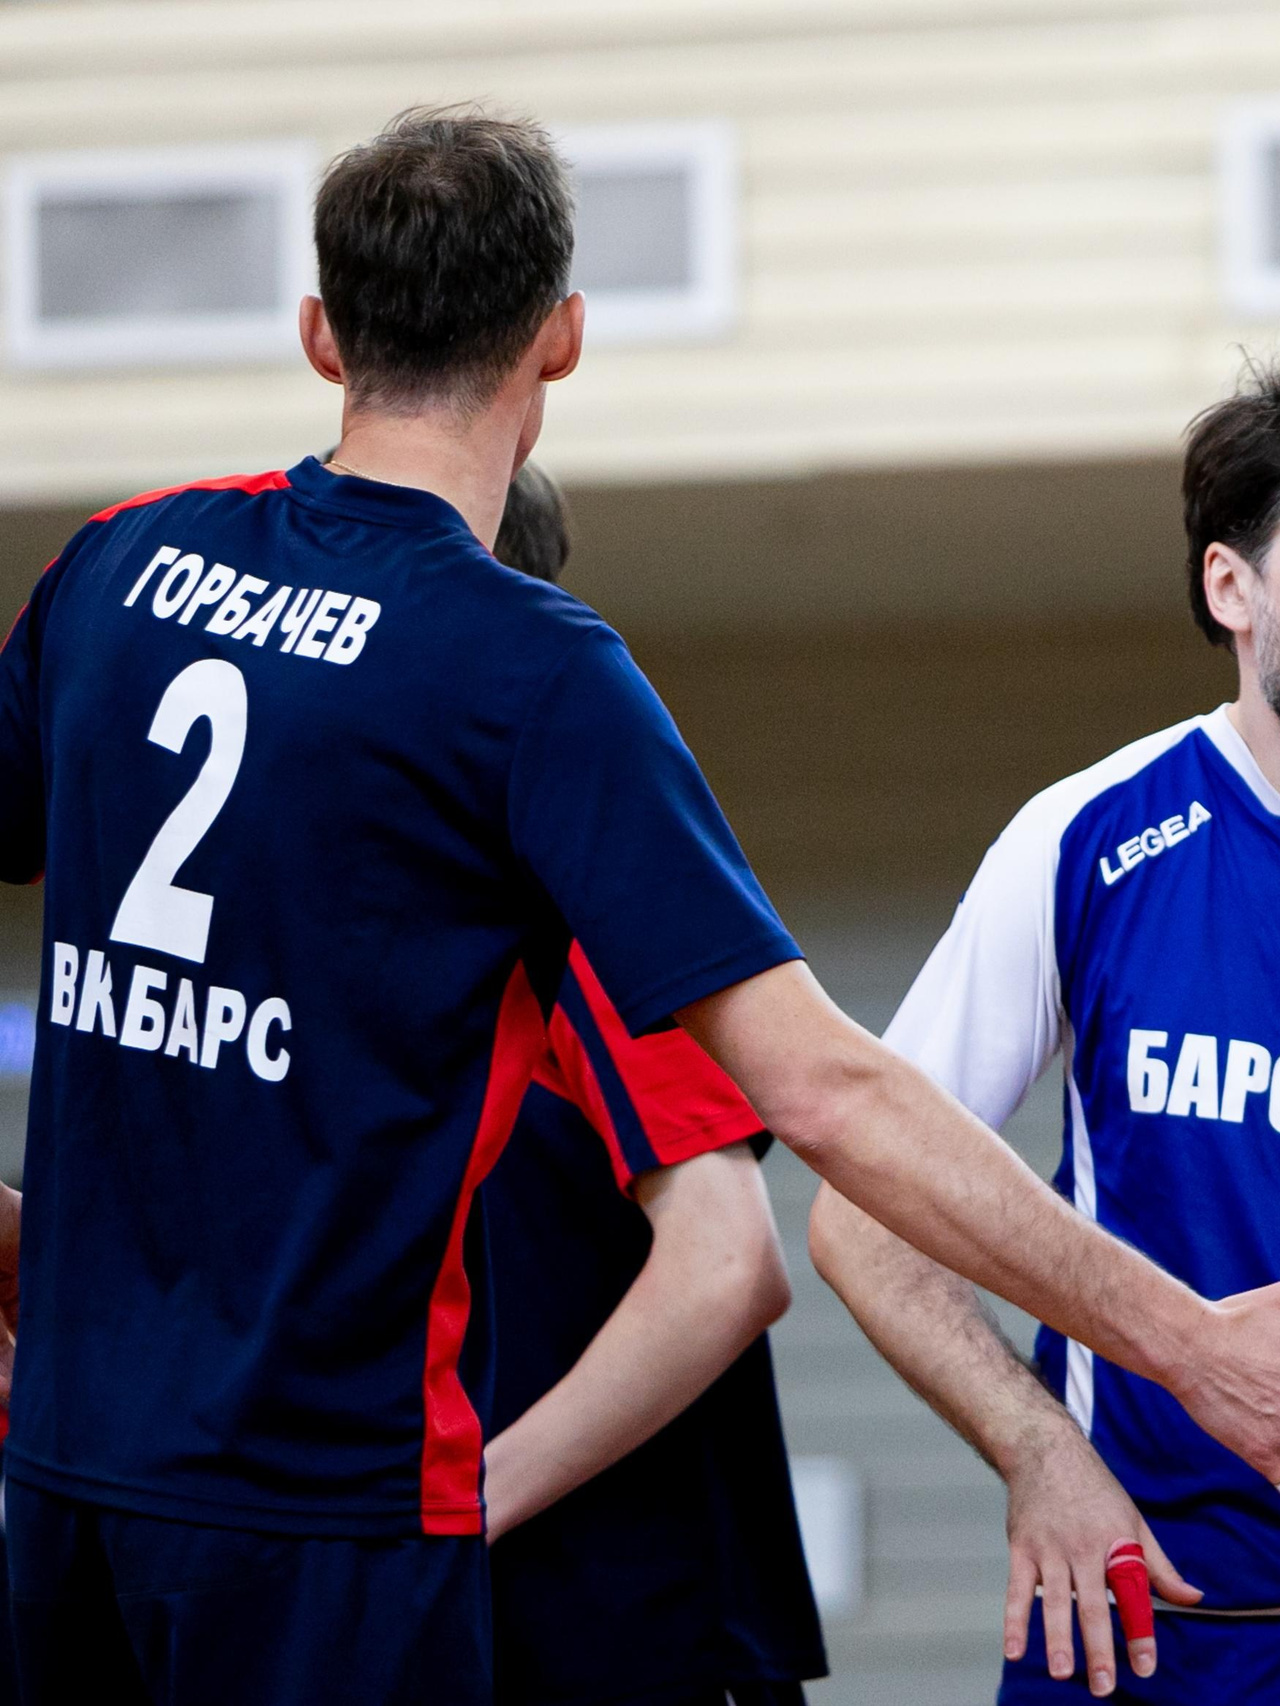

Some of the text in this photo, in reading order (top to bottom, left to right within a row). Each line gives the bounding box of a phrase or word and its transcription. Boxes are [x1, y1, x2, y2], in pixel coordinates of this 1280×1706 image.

[124, 546, 382, 665] ГОРБАЧЕВ
[110, 659, 248, 964] 2
[1099, 801, 1212, 886] LEGEA
